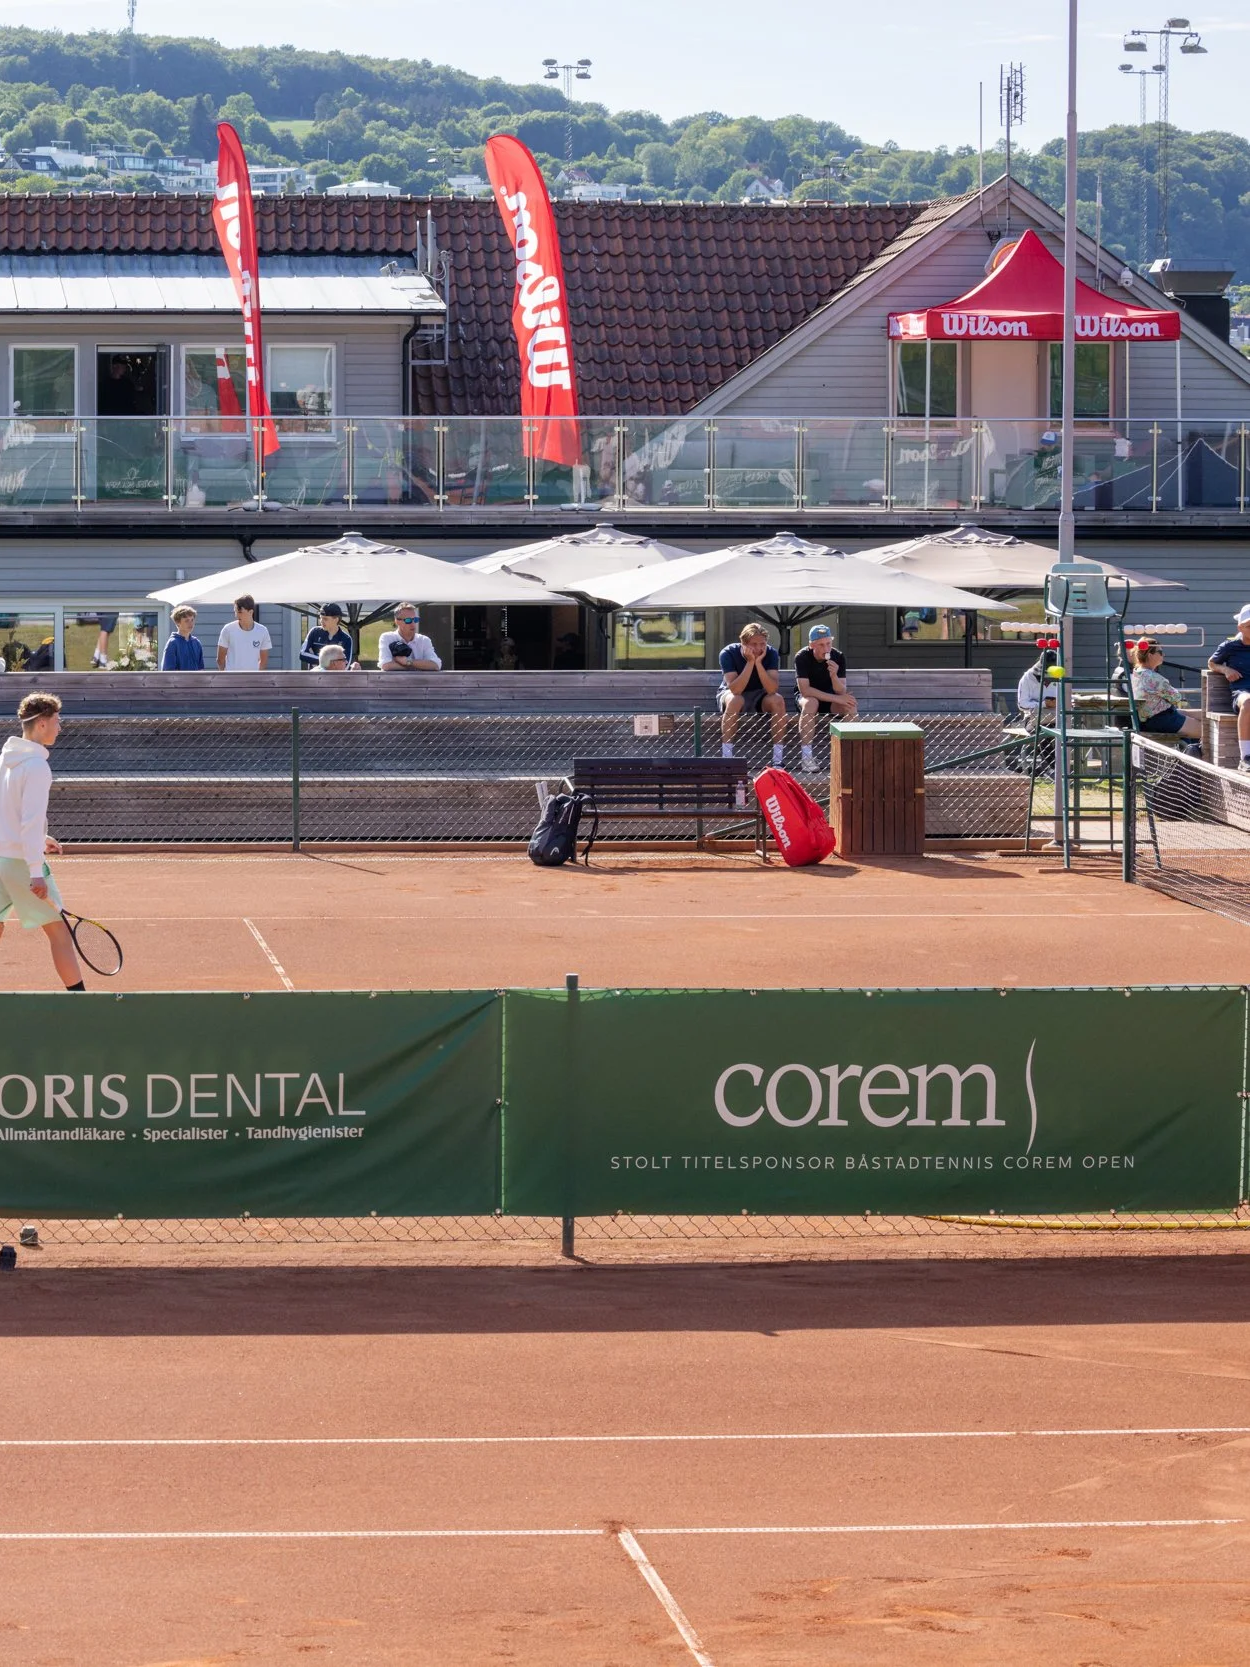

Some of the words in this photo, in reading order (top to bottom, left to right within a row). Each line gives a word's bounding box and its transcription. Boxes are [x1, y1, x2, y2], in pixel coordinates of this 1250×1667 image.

[941, 313, 1029, 337] Wilson
[1074, 315, 1161, 337] Wilson
[765, 794, 792, 850] Wilson
[146, 1072, 366, 1118] DENTAL
[714, 1063, 1006, 1127] corem
[143, 1127, 229, 1142] Specialister
[245, 1125, 364, 1141] Tandhygienister
[611, 1156, 672, 1169] STOLT
[681, 1156, 835, 1169] TITELSPONSOR
[845, 1153, 993, 1169] BÅSTADTENNIS
[1003, 1156, 1072, 1169] COREM
[1082, 1156, 1134, 1169] OPEN
